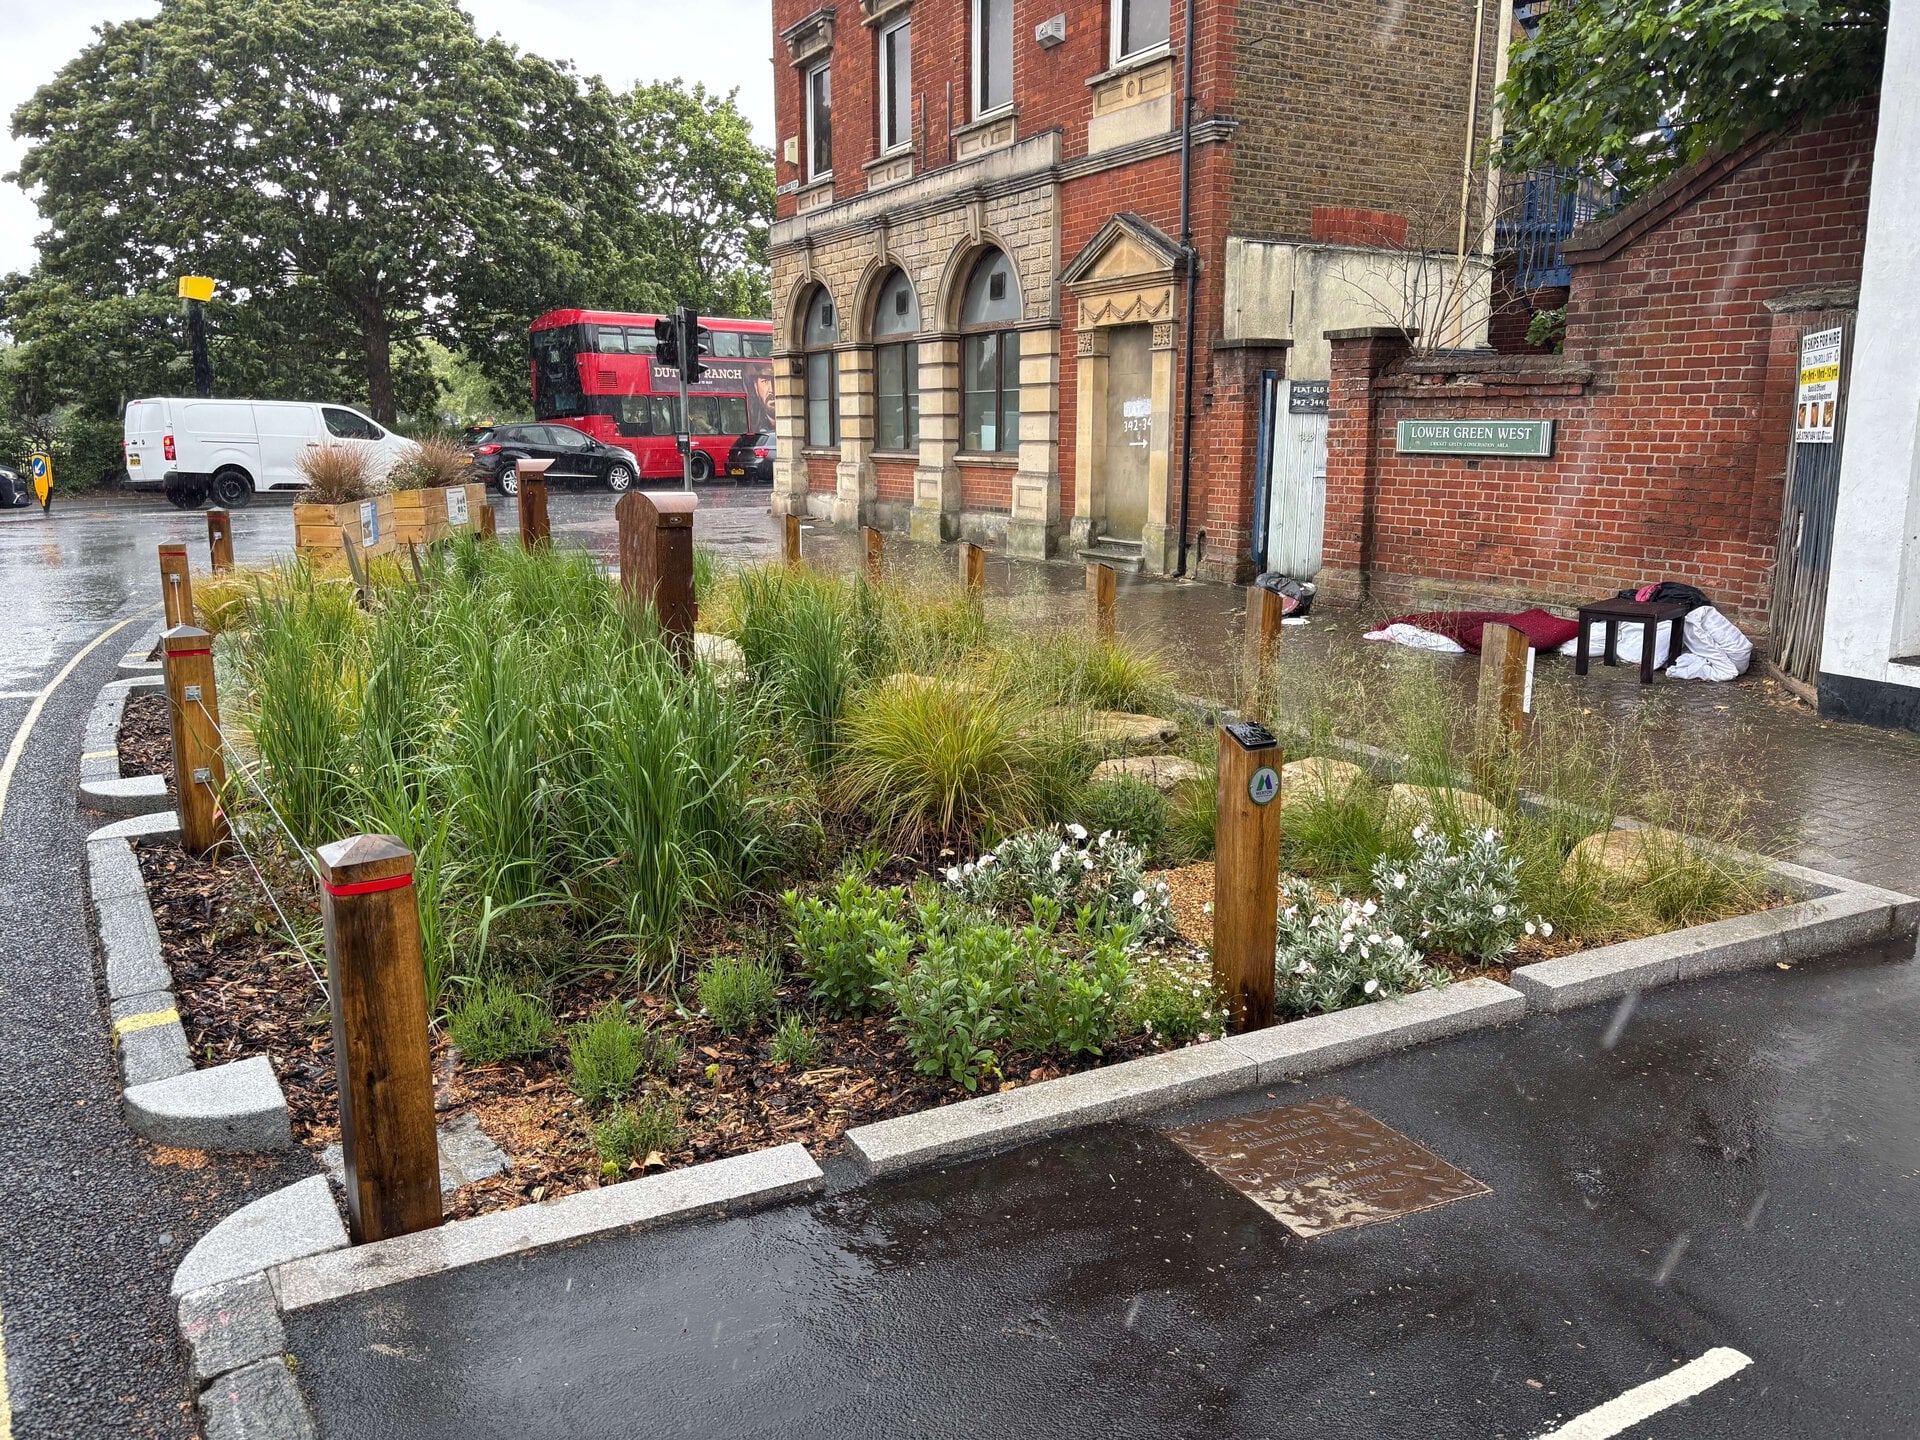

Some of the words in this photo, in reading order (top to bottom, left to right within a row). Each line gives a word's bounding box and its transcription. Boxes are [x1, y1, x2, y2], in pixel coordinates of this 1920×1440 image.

[1807, 334, 1819, 350] SKIPS
[1819, 333, 1828, 348] FOR
[1828, 330, 1840, 346] HIRE
[704, 368, 742, 379] RANCH
[1293, 386, 1311, 394] FLAT
[1312, 386, 1324, 394] OLD
[1411, 426, 1450, 439] LOWER
[1453, 426, 1494, 440] GREEN
[1497, 427, 1533, 441] WEST
[1463, 441, 1495, 449] CONSERVATION
